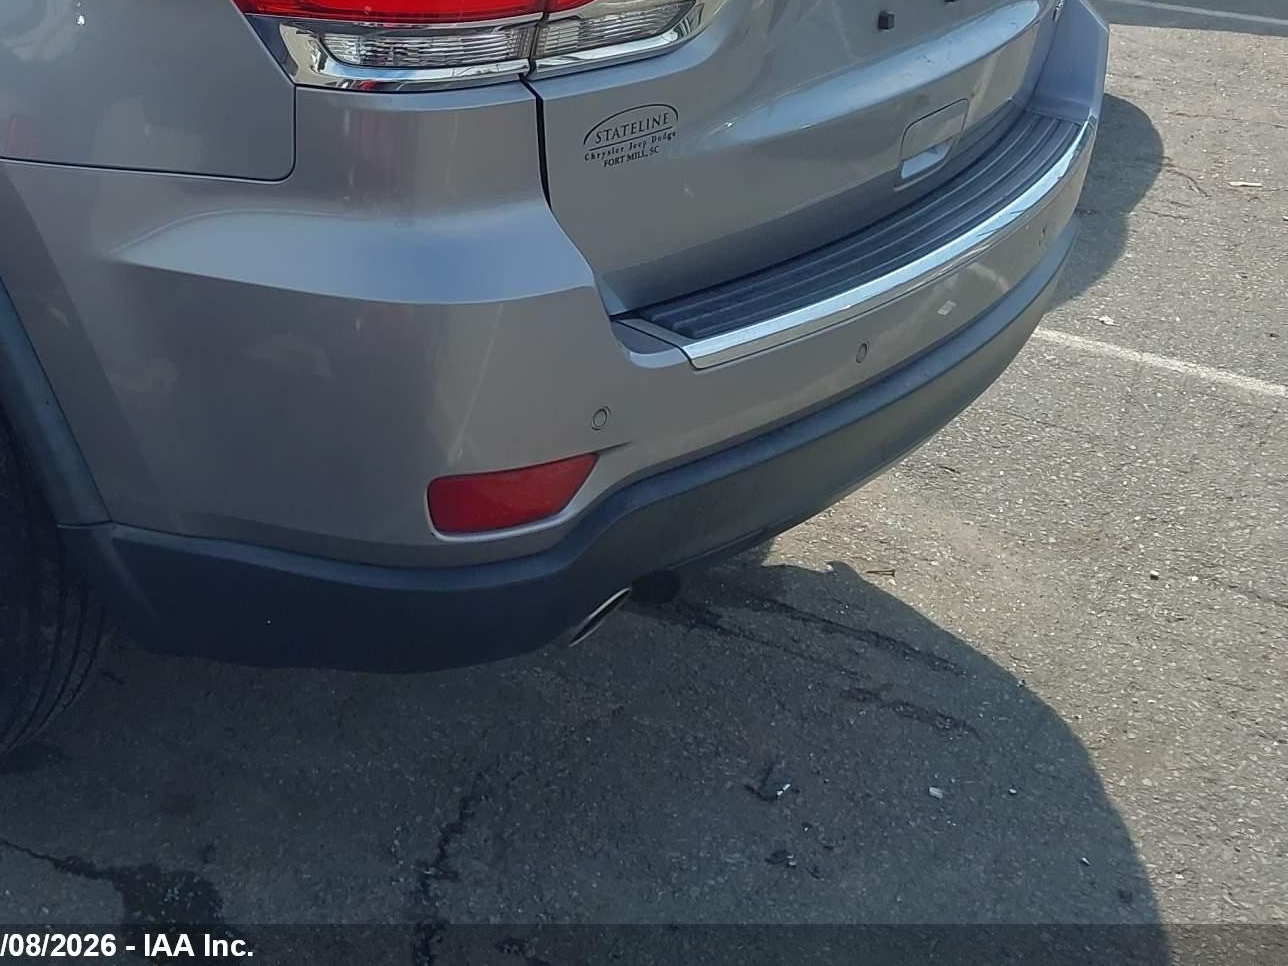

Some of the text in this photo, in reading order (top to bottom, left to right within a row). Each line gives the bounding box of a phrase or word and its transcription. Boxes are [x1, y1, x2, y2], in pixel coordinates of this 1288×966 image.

[594, 112, 670, 145] STATELINE
[584, 130, 677, 162] Chrysler Jeep Dodge
[603, 155, 625, 168] FORT
[649, 145, 660, 156] SC
